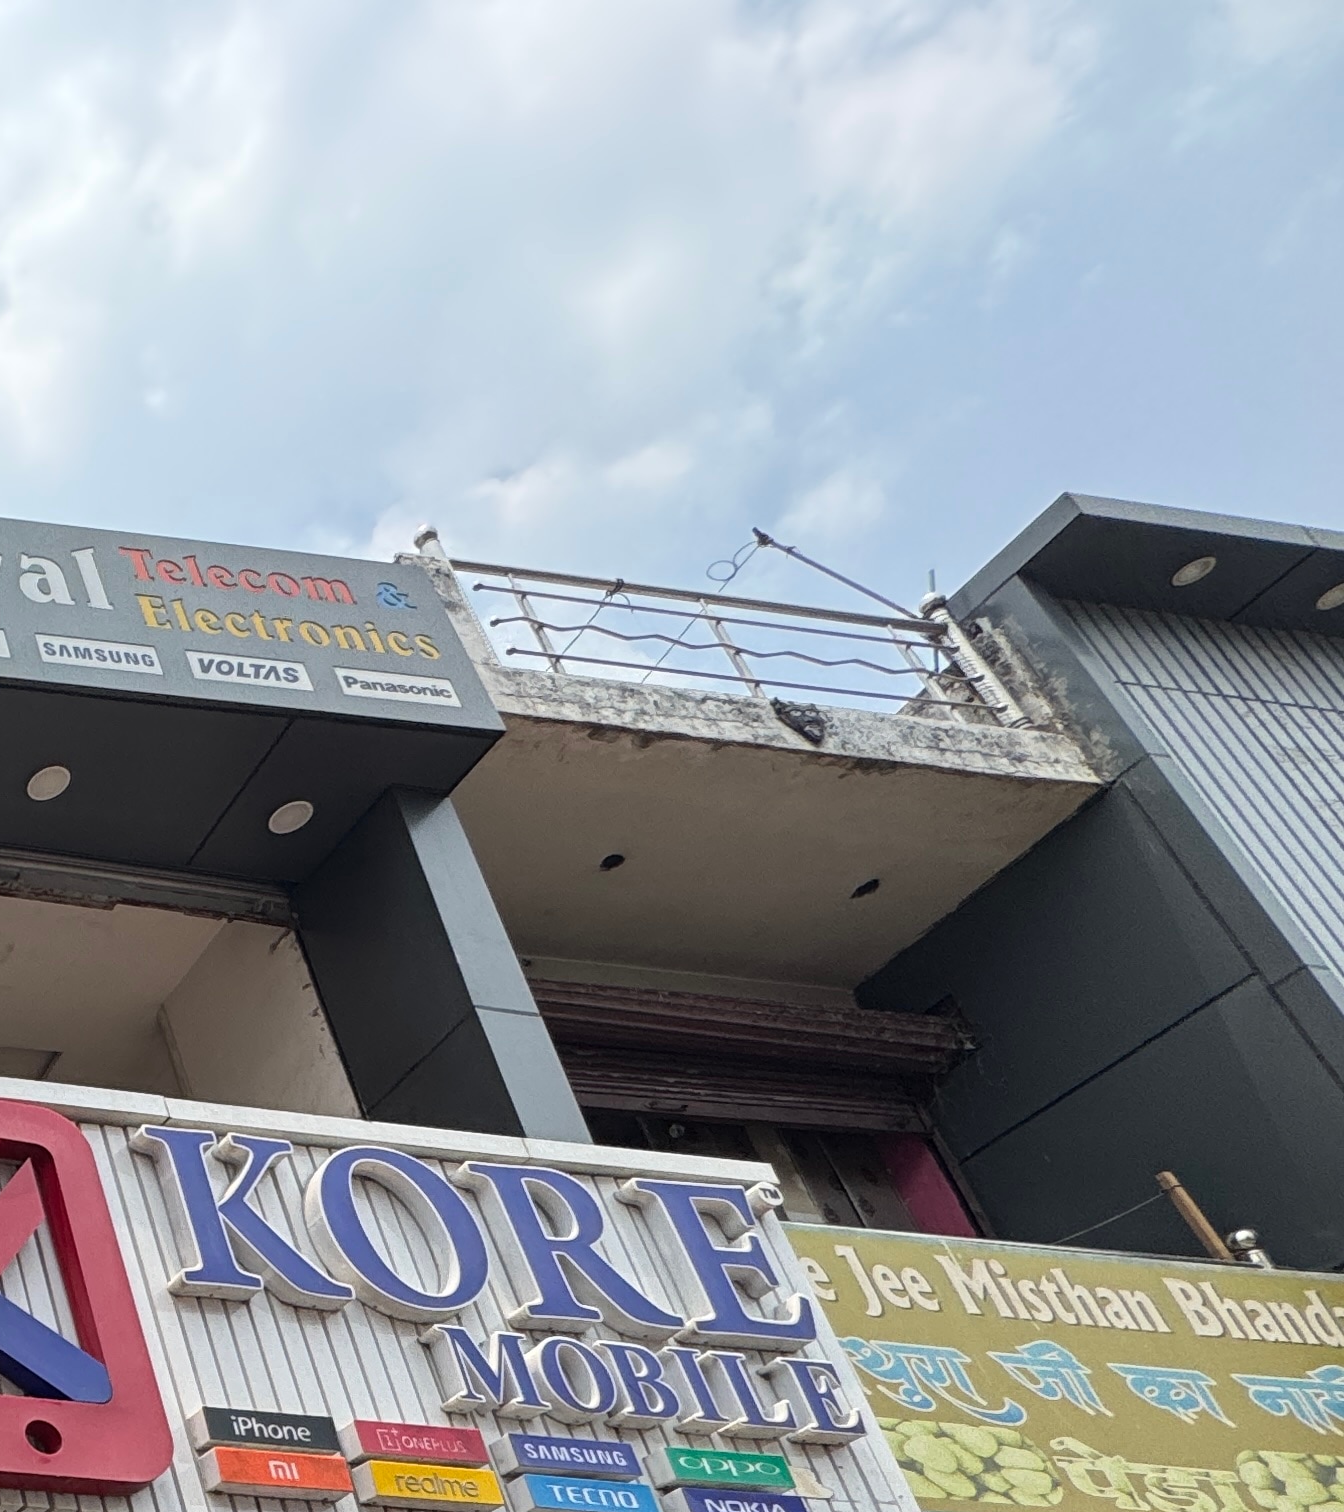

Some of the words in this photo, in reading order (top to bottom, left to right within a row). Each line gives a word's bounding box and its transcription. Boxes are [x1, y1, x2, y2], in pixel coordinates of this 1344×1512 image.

[117, 545, 358, 605] Telecom
[376, 581, 417, 611] &
[135, 593, 440, 662] Electronics
[42, 640, 156, 669] SAMSUNG
[196, 658, 300, 686] VOLTAS
[341, 674, 453, 702] Panasonic
[136, 1123, 819, 1350] KORE
[834, 1245, 943, 1318] Jee
[935, 1252, 1172, 1333] Misthan
[422, 1323, 866, 1446] MOBILE
[1107, 1362, 1238, 1428] का
[230, 1414, 312, 1443] iPhone
[401, 1435, 467, 1454] ONEPLUS
[524, 1442, 629, 1469] SAMSUNG
[394, 1473, 480, 1499] realme
[547, 1485, 640, 1510] TECNO
